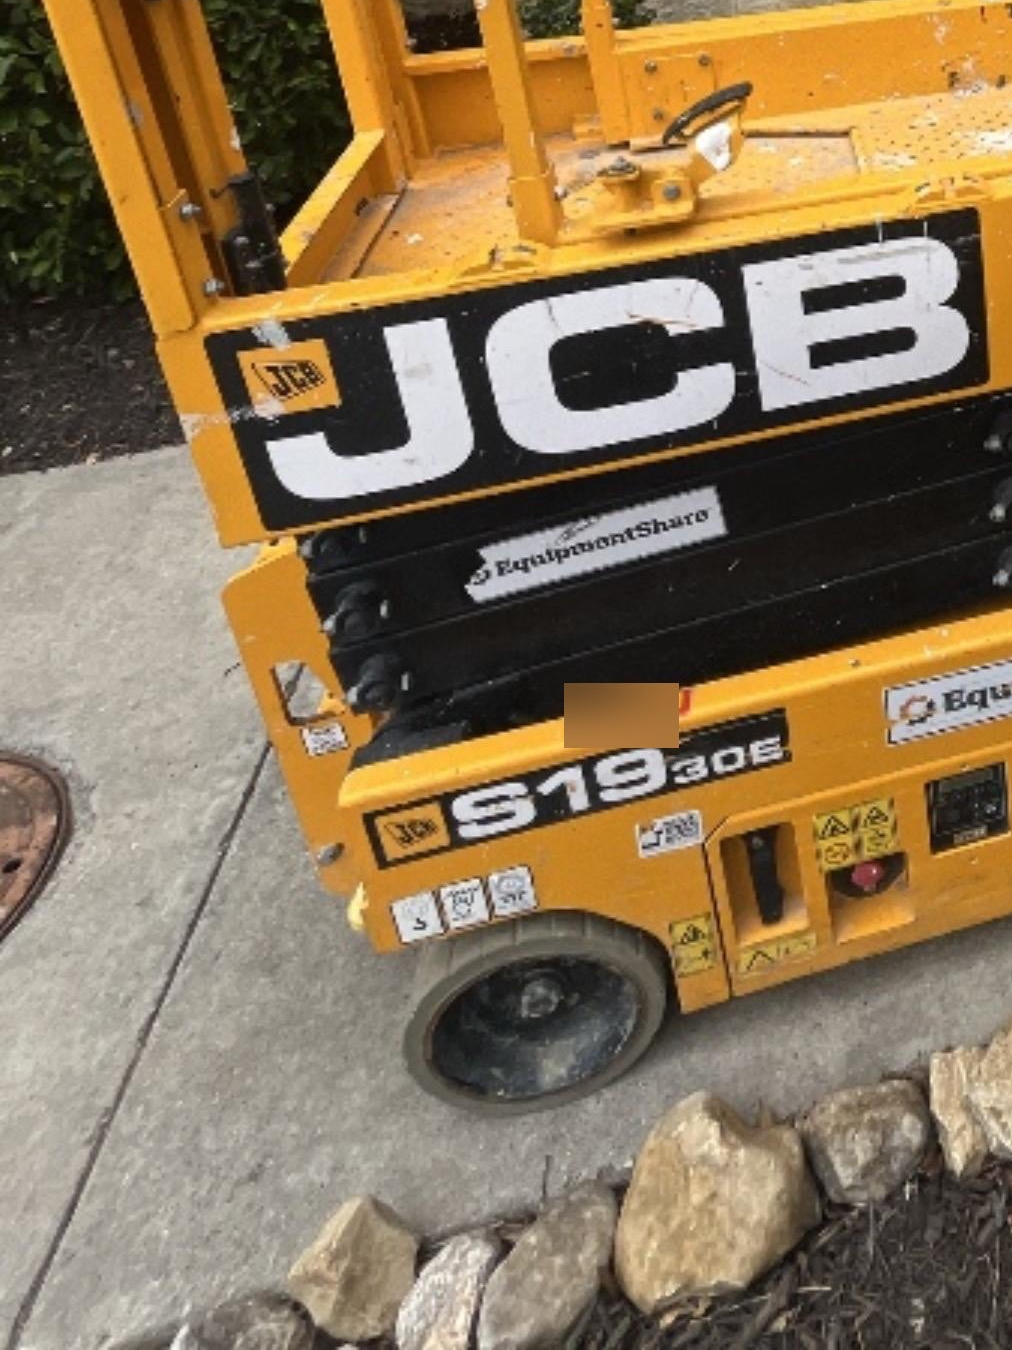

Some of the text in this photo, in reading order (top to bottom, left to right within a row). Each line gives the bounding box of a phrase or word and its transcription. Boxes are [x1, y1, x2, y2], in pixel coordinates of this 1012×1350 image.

[261, 359, 325, 399] JCB
[264, 235, 971, 501] JCB
[495, 506, 710, 578] EquipmentShare
